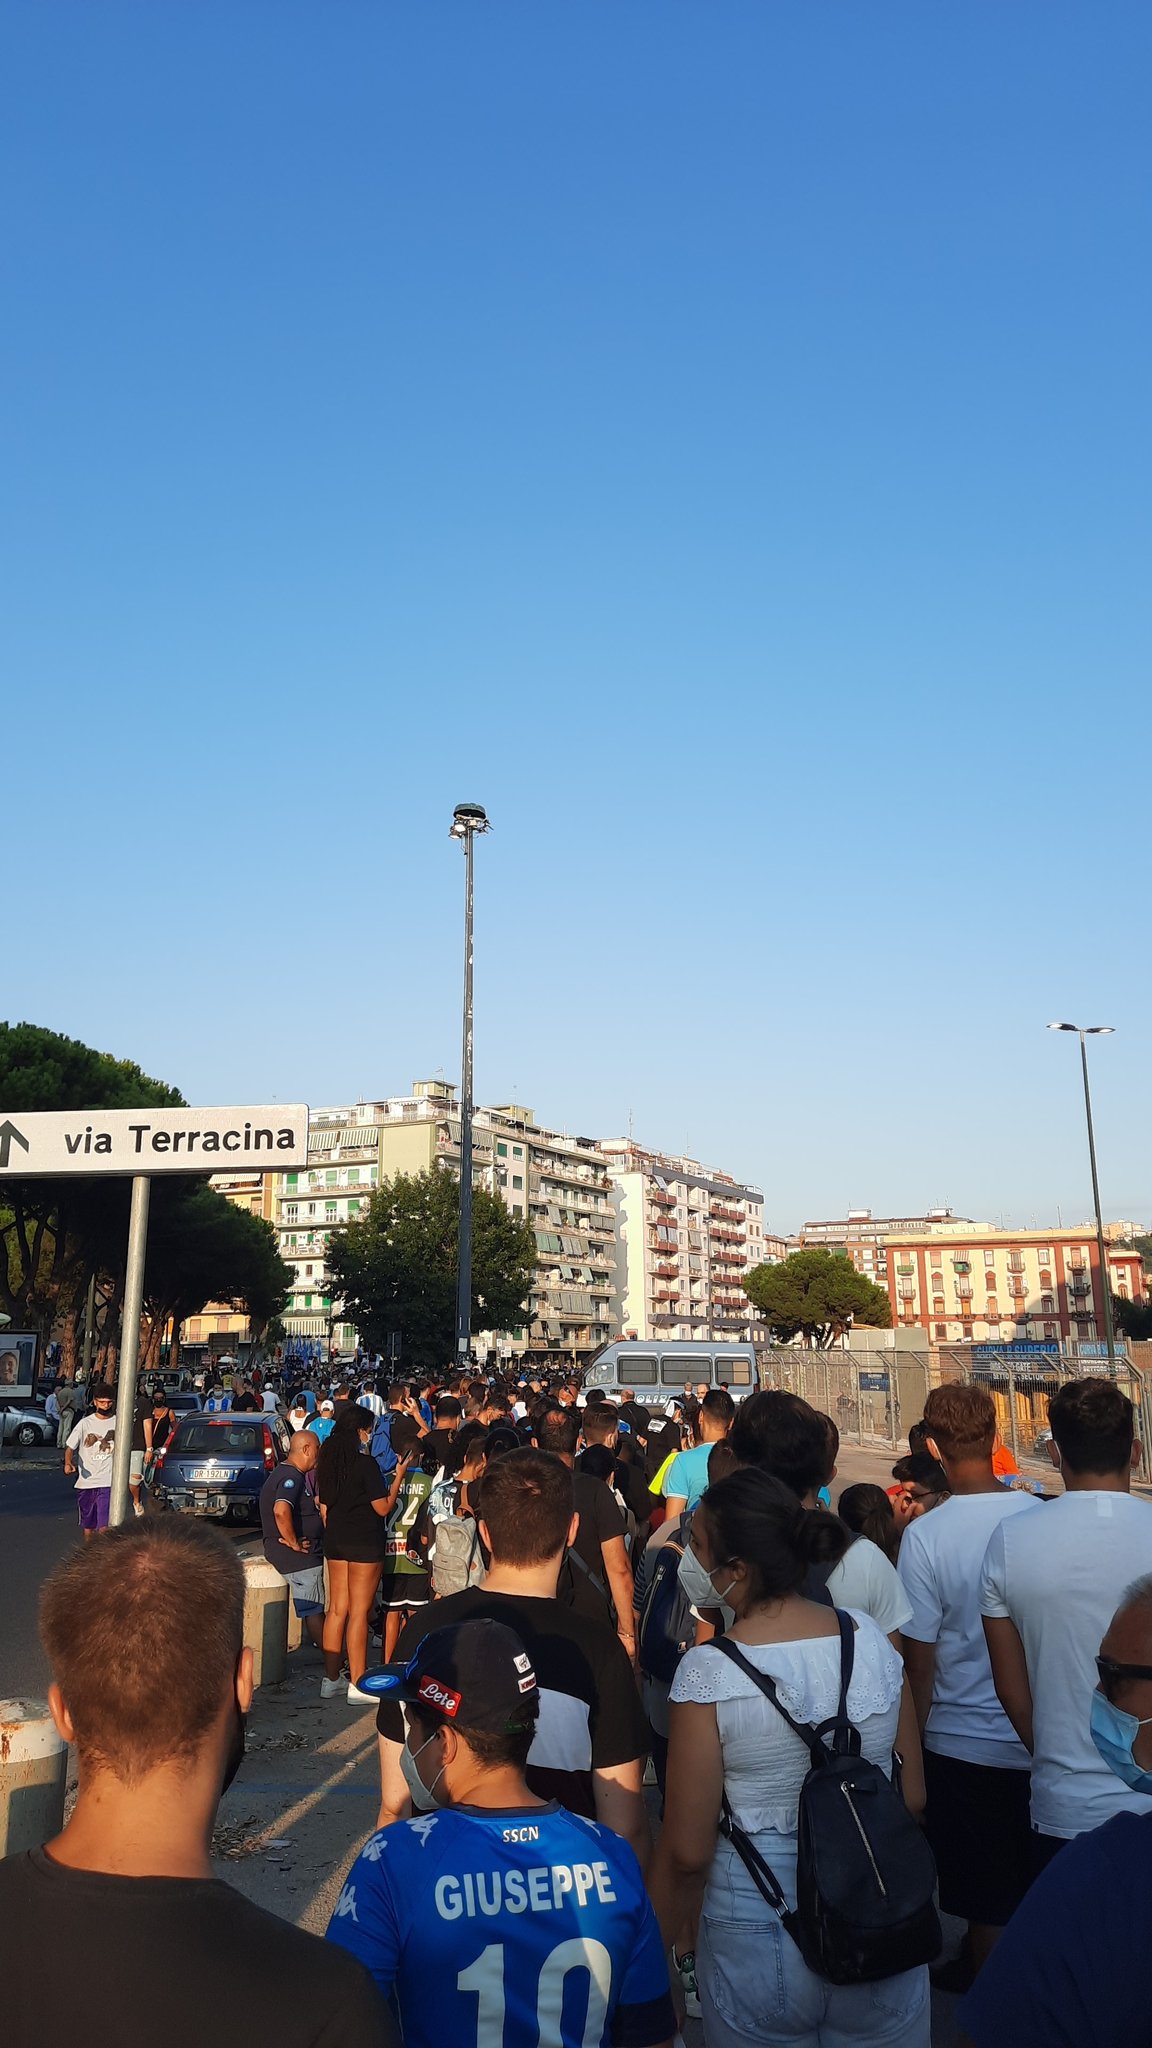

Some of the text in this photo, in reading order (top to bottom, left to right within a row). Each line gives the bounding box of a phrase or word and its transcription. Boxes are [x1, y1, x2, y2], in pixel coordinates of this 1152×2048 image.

[65, 1122, 295, 1154] via Terracina
[1014, 1343, 1059, 1353] SUPERIO
[636, 1394, 669, 1405] OLIZ
[386, 1541, 407, 1554] KIM
[419, 1683, 456, 1710] Lete
[503, 1826, 539, 1843] SSCN
[434, 1861, 617, 1920] GIUSEPPE
[457, 1937, 612, 2048] 10
